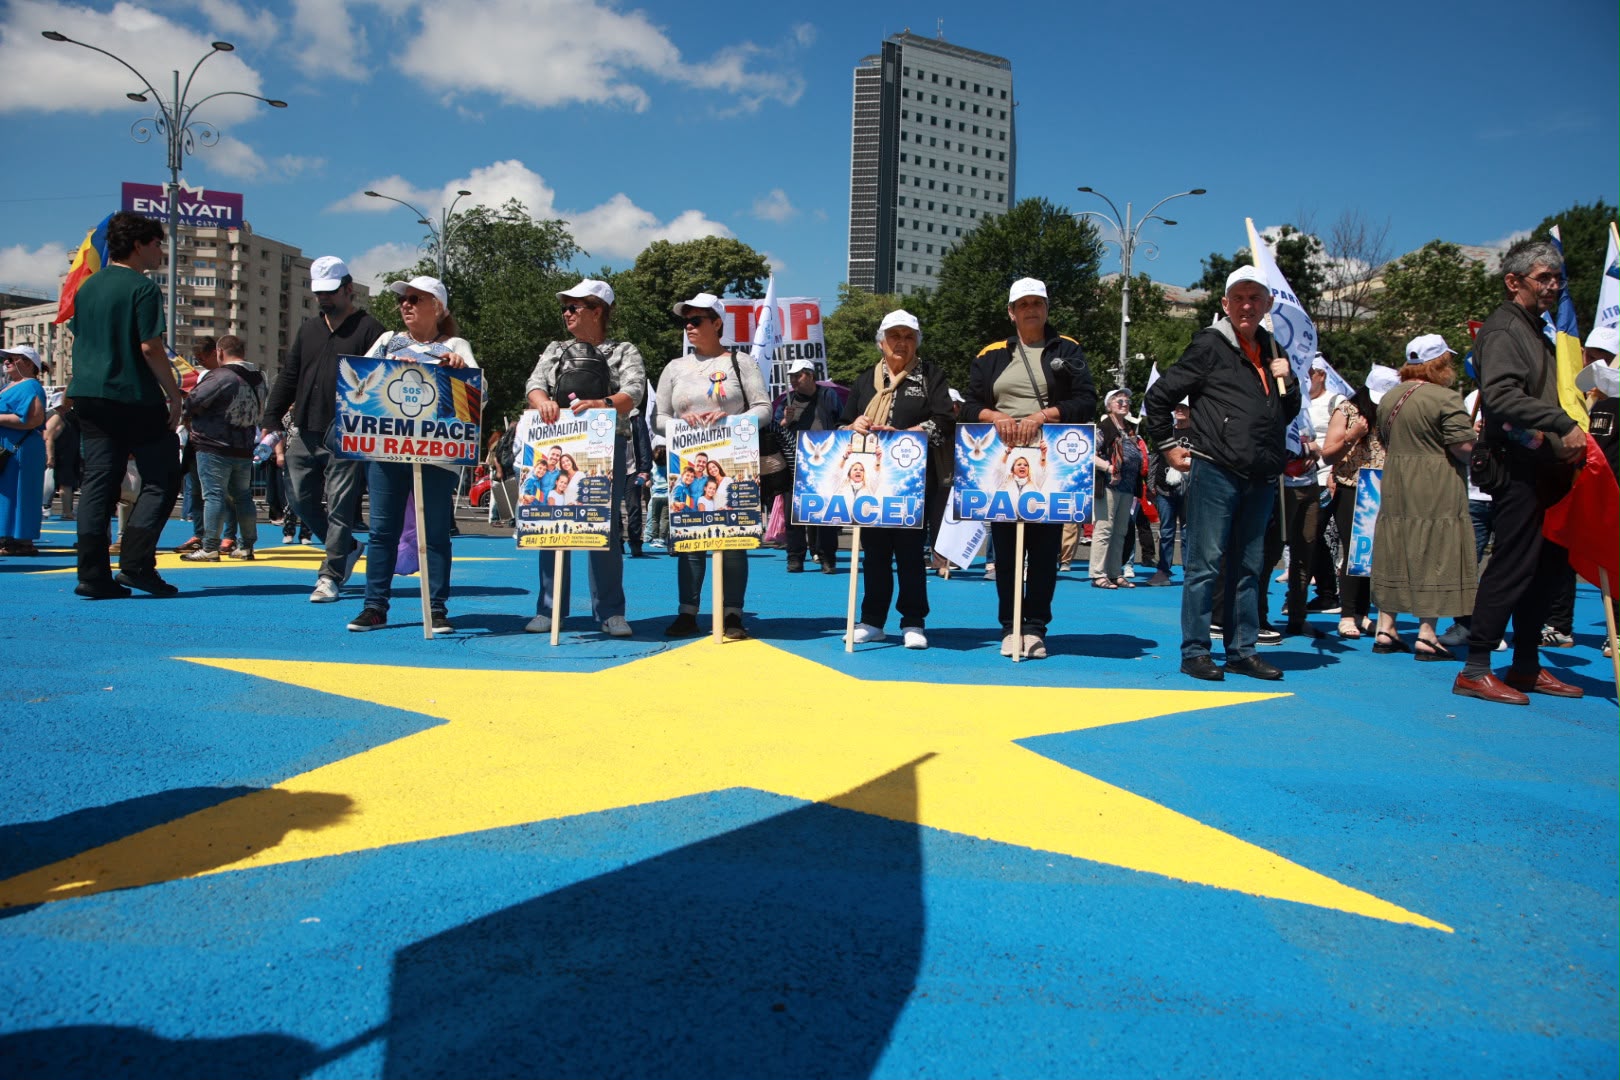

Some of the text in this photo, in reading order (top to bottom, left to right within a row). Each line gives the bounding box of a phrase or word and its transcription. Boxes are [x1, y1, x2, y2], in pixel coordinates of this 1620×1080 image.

[402, 386, 421, 395] SOS
[405, 395, 418, 403] RO
[342, 414, 476, 441] VREM PACE
[342, 435, 376, 452] NU
[798, 493, 917, 526] PACE!
[960, 489, 1087, 523] PACE!
[525, 537, 538, 545] HAI
[549, 535, 561, 544] TU!
[679, 542, 692, 550] HAI
